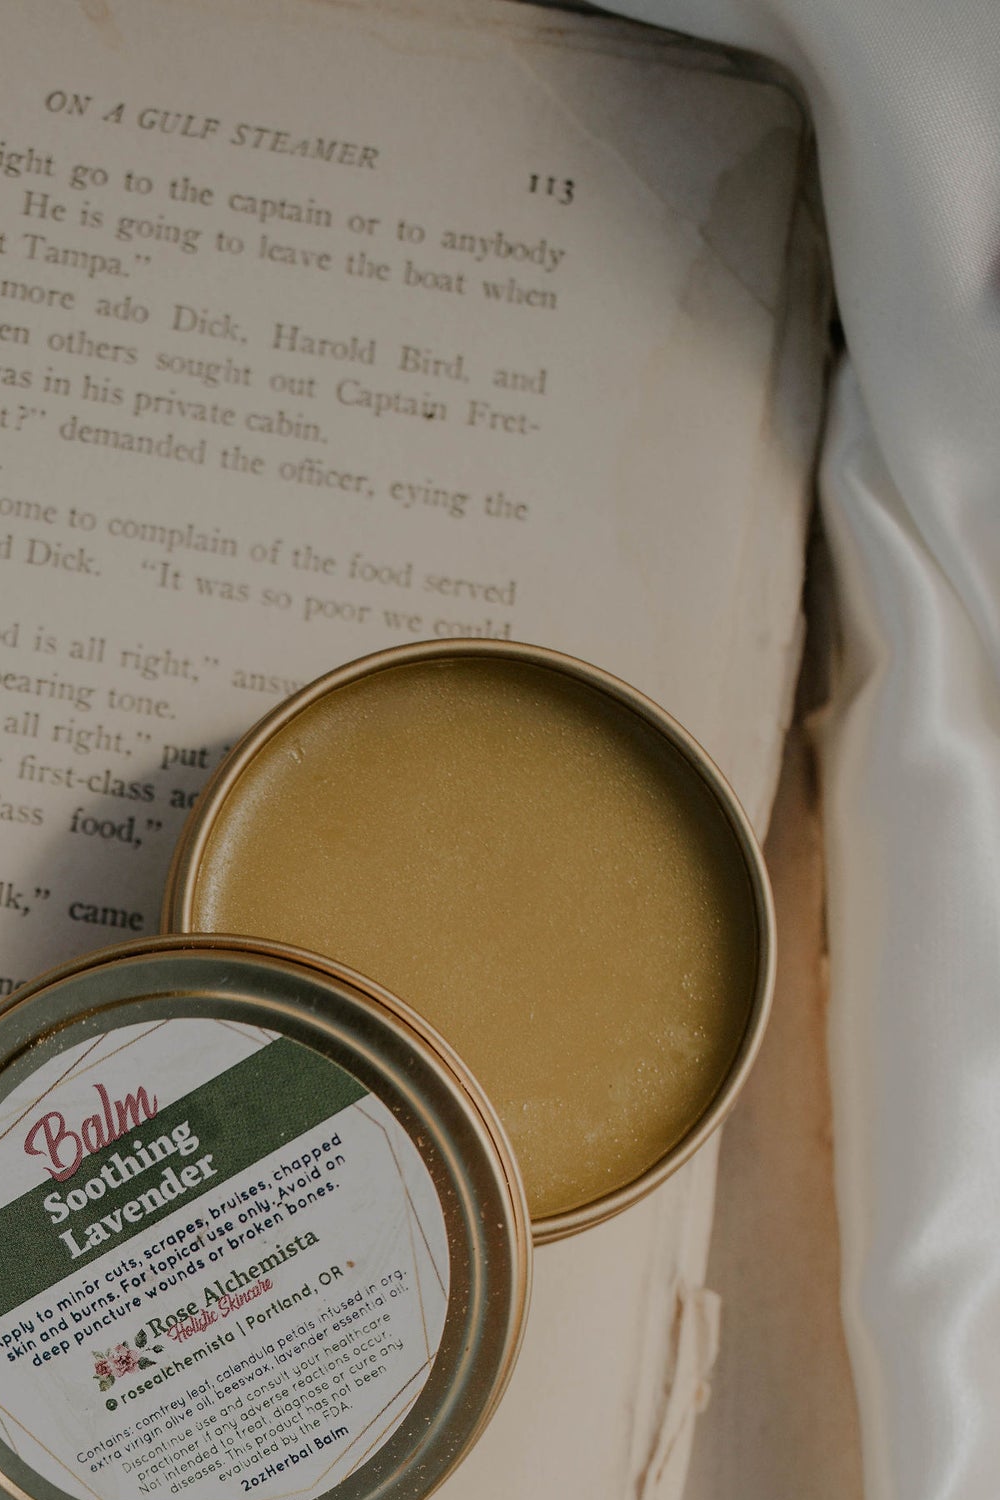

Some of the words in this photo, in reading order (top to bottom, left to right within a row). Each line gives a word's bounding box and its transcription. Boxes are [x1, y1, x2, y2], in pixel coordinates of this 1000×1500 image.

[46, 90, 92, 116] ON
[102, 103, 125, 124] A
[138, 108, 220, 140] GULF
[230, 124, 379, 169] STEAMER
[70, 165, 109, 190] go
[125, 172, 153, 193] to
[170, 177, 213, 206] the
[228, 194, 332, 227] captain
[348, 215, 380, 235] or
[398, 221, 425, 242] to
[442, 231, 566, 266] anybody
[529, 173, 575, 206] 113
[24, 190, 66, 222] He
[81, 208, 102, 227] is
[116, 217, 202, 252] going
[217, 232, 244, 252] to
[260, 235, 332, 270] leave
[347, 252, 390, 281] the
[405, 260, 464, 294] boat
[483, 281, 556, 310] when
[68, 806, 163, 850] food,”
[68, 895, 144, 931] came
[24, 1084, 158, 1182] Balm
[43, 1120, 201, 1224] Soothing
[36, 1309, 53, 1322] to
[57, 1280, 100, 1311] minor
[105, 1259, 143, 1282] cuts,
[144, 1219, 209, 1259] scrapes,
[208, 1181, 272, 1219] bruises,
[273, 1133, 342, 1180] chapped
[59, 1152, 218, 1259] Lavender
[7, 1340, 37, 1362] skin
[40, 1317, 68, 1342] and
[70, 1293, 120, 1323] burns.
[120, 1272, 146, 1293] For
[150, 1235, 205, 1275] topical
[206, 1222, 234, 1241] use
[238, 1200, 276, 1223] only.
[279, 1166, 322, 1199] Avoid
[326, 1155, 345, 1170] on
[33, 1341, 70, 1366] deep
[74, 1297, 141, 1345] puncture
[145, 1260, 205, 1298] wounds
[209, 1247, 224, 1262] or
[227, 1213, 283, 1250] broken
[285, 1182, 339, 1215] bones.
[146, 1299, 200, 1338] Rose
[203, 1231, 320, 1307] Alchemista
[245, 1283, 318, 1330] Portland,
[318, 1266, 344, 1285] OR
[167, 1308, 219, 1343] Holistic
[217, 1277, 273, 1318] Skincare
[77, 1427, 134, 1463] Contains:
[136, 1397, 186, 1430] comfrey
[186, 1379, 215, 1400] leaf,
[216, 1344, 275, 1383] calendula
[277, 1321, 315, 1350] petals
[319, 1290, 363, 1323] infused
[365, 1285, 376, 1295] in
[381, 1270, 406, 1286] org.
[90, 1450, 122, 1472] extra
[165, 1409, 193, 1429] olive
[274, 1328, 328, 1365] lavender
[332, 1294, 387, 1331] essential
[219, 1441, 279, 1481] evaluated
[280, 1433, 298, 1447] by
[299, 1420, 320, 1435] the
[322, 1402, 353, 1420] FDA.
[313, 1427, 349, 1450] Balm
